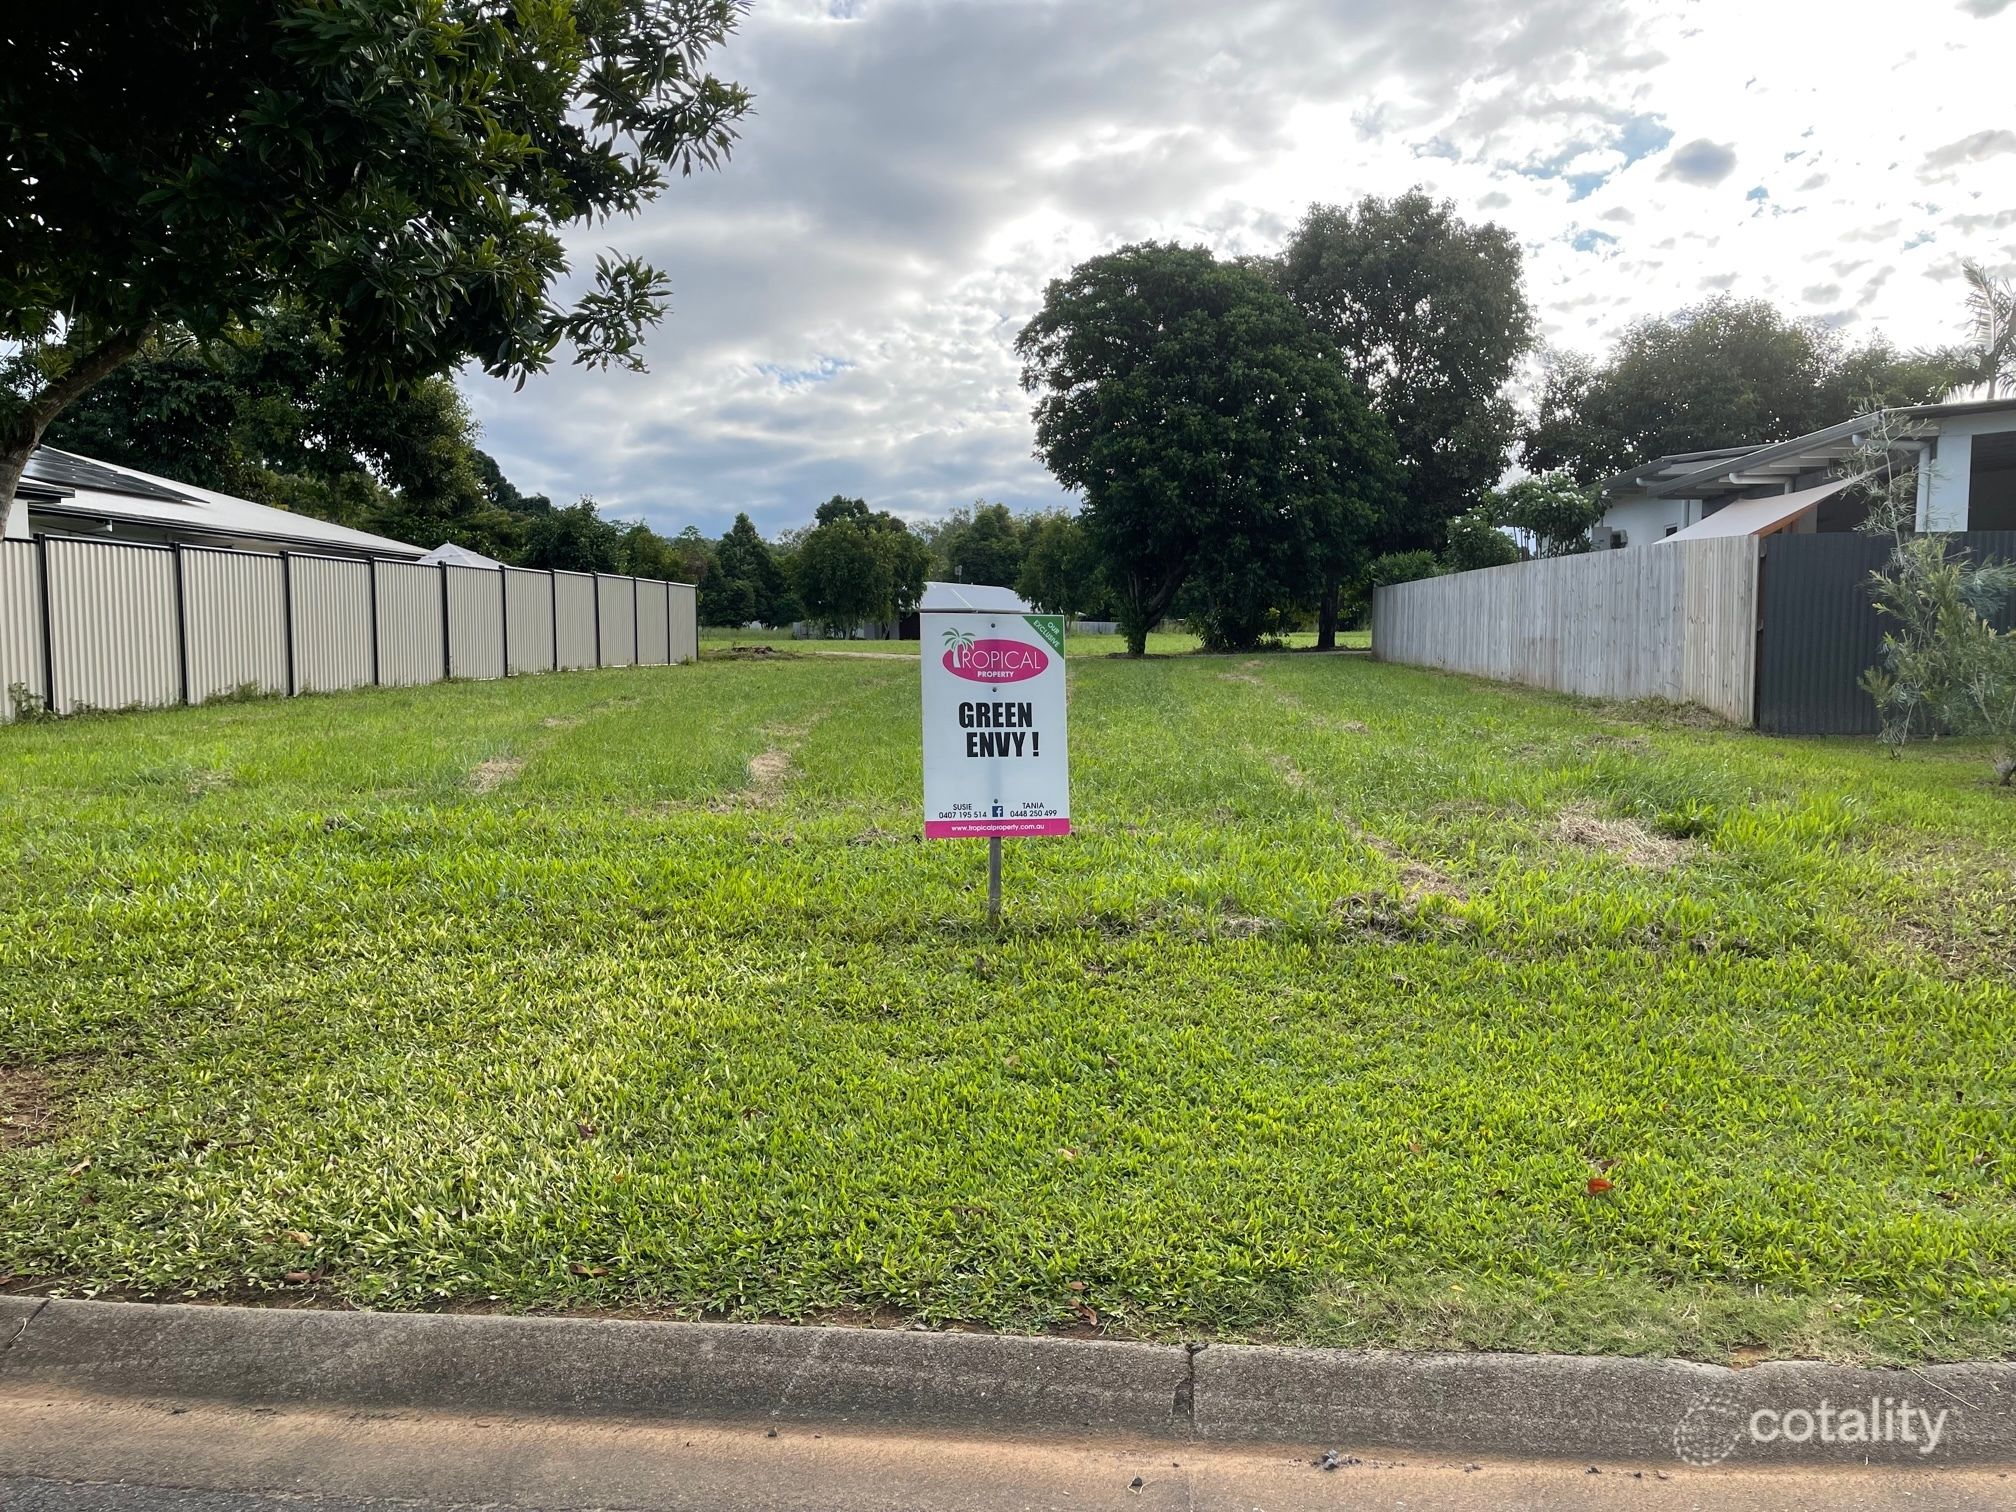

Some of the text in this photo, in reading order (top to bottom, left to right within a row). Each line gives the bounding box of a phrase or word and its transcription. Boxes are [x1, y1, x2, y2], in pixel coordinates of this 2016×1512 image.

[1047, 621, 1060, 635] OUR
[1033, 619, 1060, 648] EXCLUSIVE
[958, 701, 1033, 728] GREEN
[952, 803, 972, 811] SUSIE
[1022, 802, 1044, 810] TANIA
[938, 811, 957, 819] 0407
[1009, 810, 1028, 818] 0448
[1044, 809, 1058, 817] 499
[951, 823, 1045, 832] www.tropicalproperty.com.au
